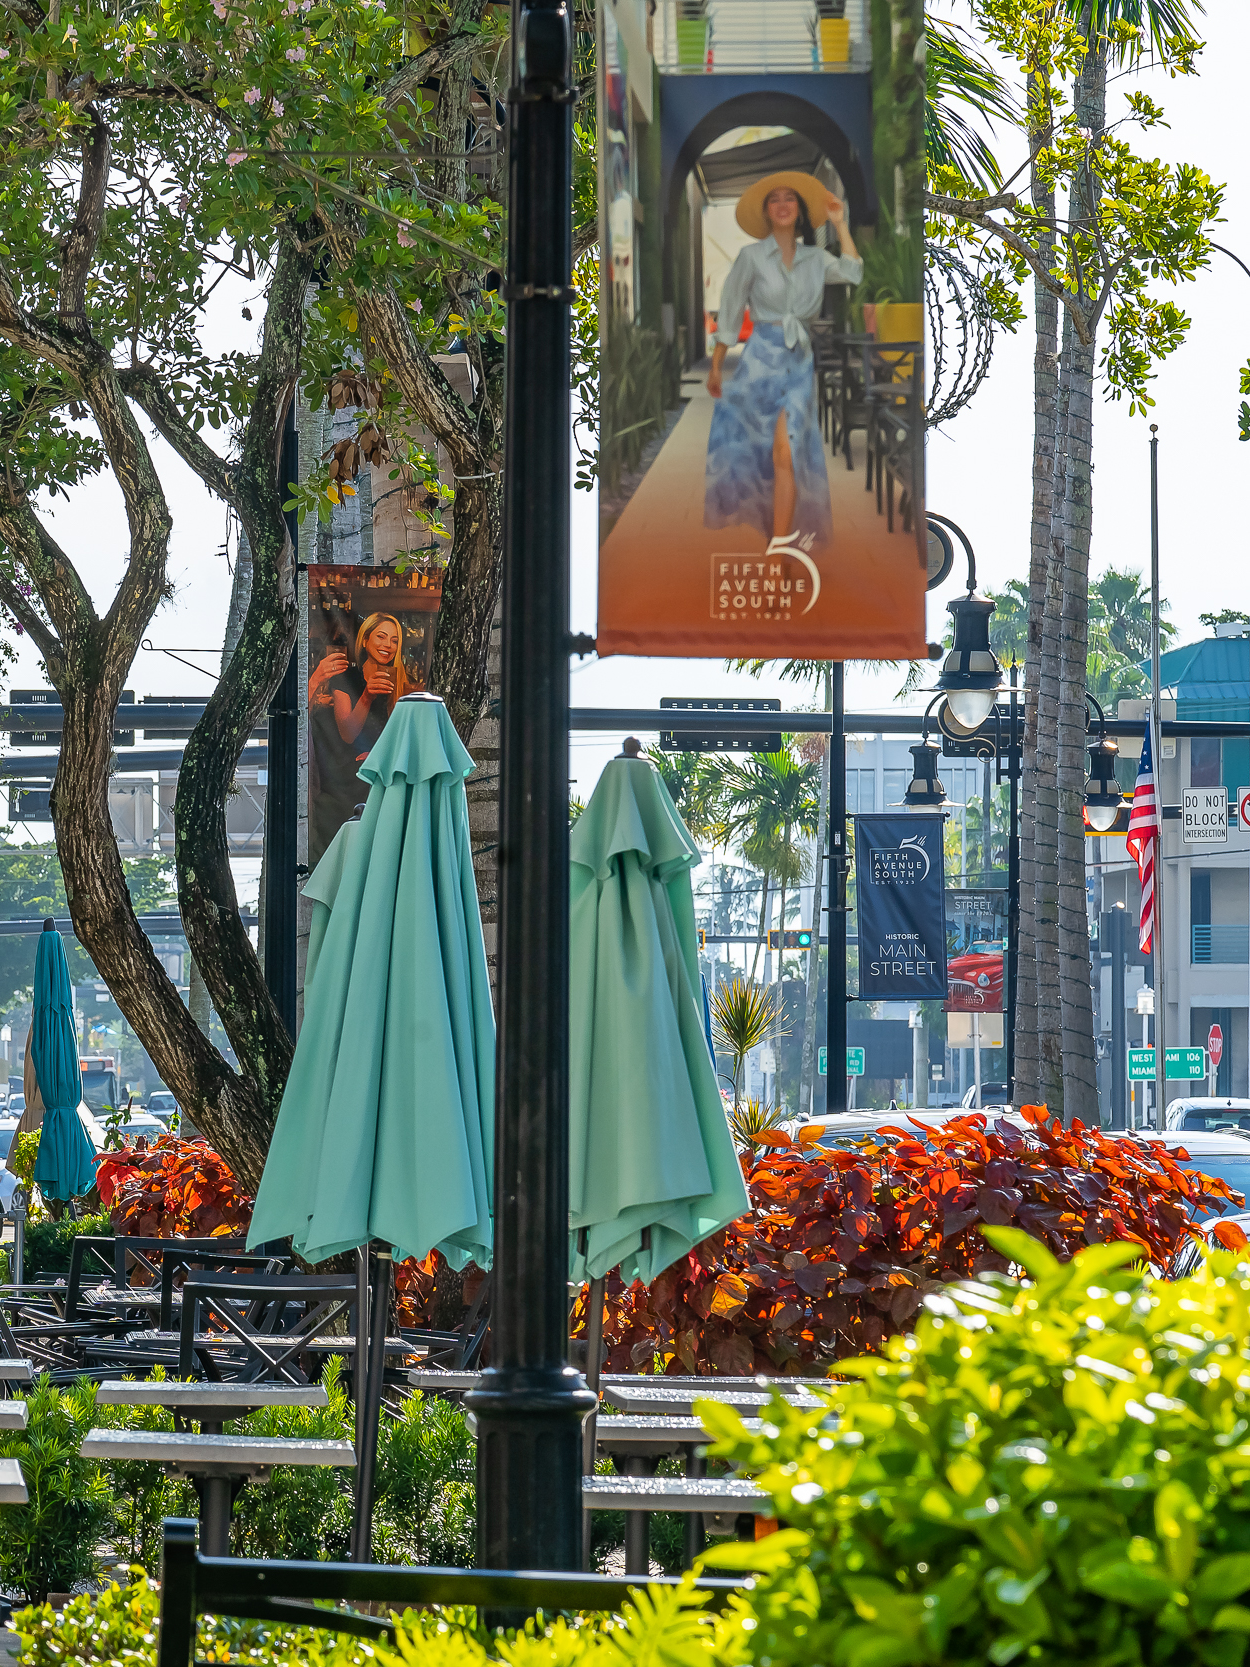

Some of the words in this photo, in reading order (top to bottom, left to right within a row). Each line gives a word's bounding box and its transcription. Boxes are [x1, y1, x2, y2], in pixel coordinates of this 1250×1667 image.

[719, 563, 782, 577] FIFTH
[719, 579, 806, 593] AVENUE
[719, 594, 792, 609] SOUTH
[1185, 795, 1198, 808] DO
[1205, 795, 1225, 808] NOT
[1185, 813, 1226, 826] BLOCK
[1185, 829, 1226, 838] INTERSECTION
[874, 853, 908, 861] FIFTH
[874, 861, 922, 870] AVENUE
[874, 870, 915, 879] SOUTH
[879, 943, 926, 958] MAIN
[870, 961, 937, 976] STREET
[1209, 1037, 1222, 1053] STOP
[1131, 1053, 1154, 1063] WEST
[1165, 1053, 1180, 1062] AMI
[1186, 1052, 1200, 1062] 106
[1189, 1065, 1201, 1075] 110
